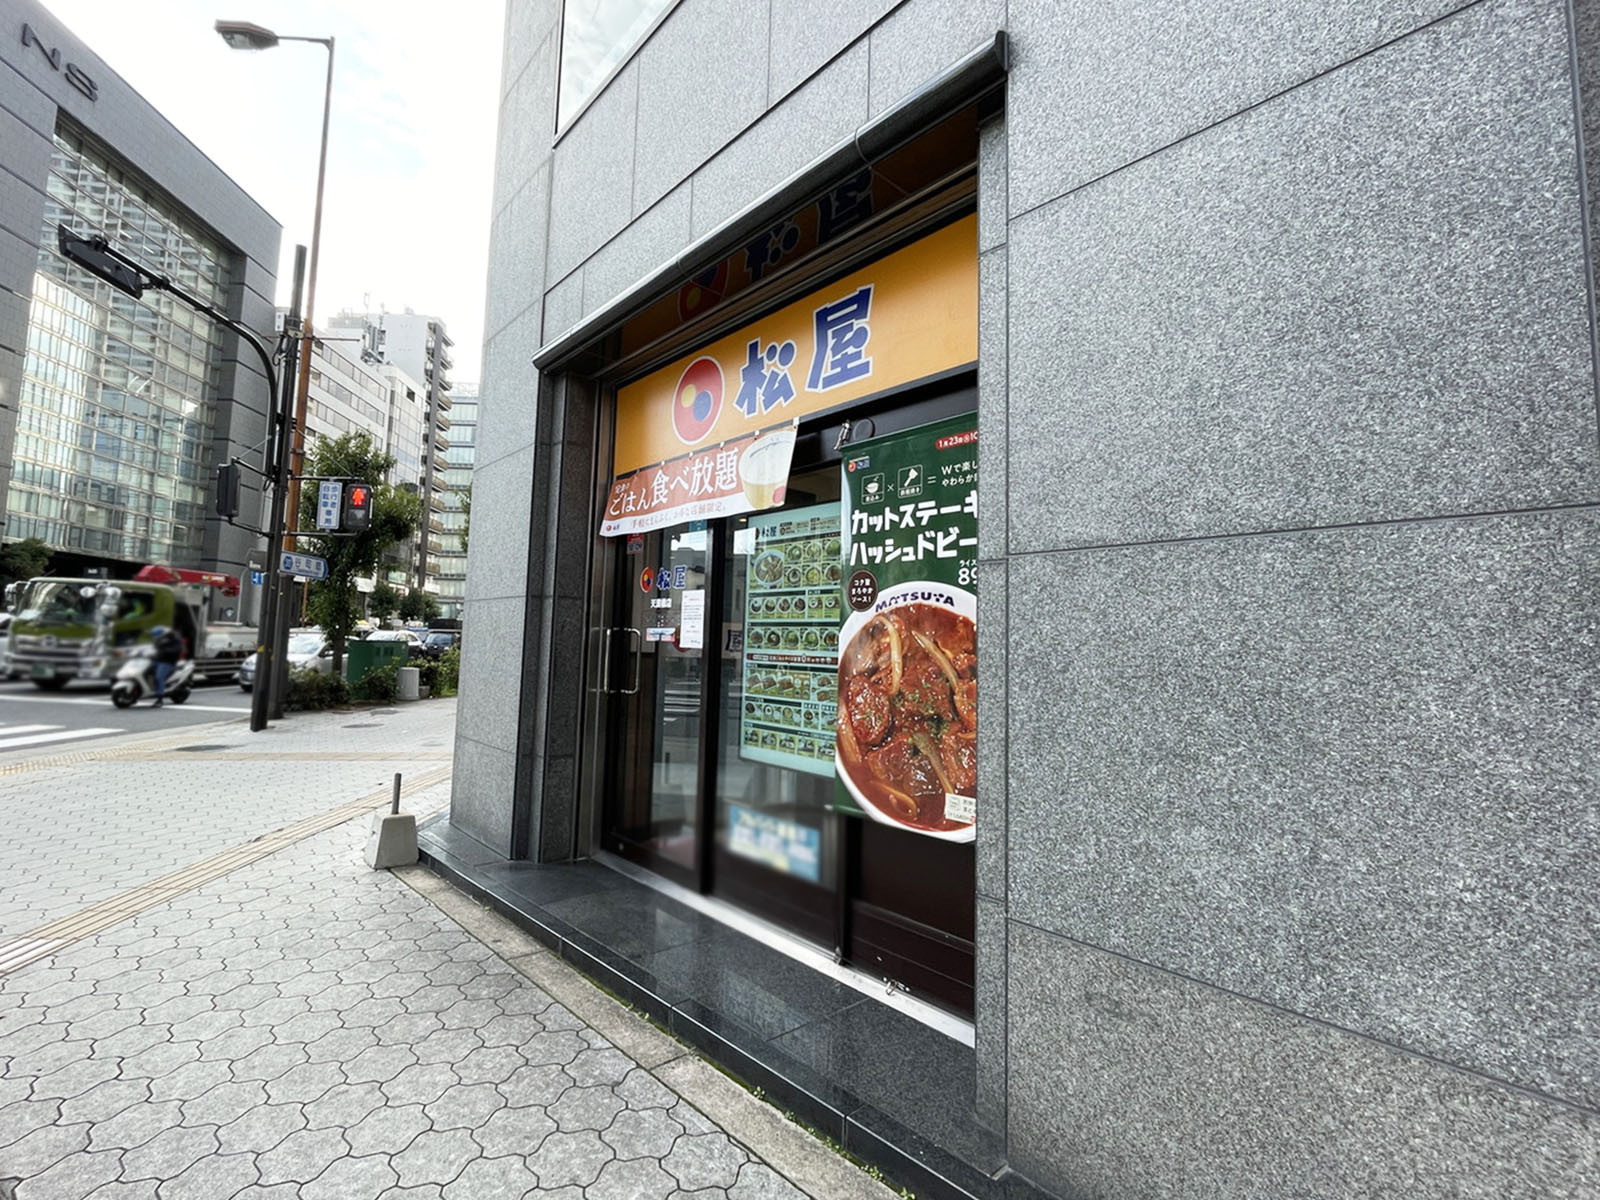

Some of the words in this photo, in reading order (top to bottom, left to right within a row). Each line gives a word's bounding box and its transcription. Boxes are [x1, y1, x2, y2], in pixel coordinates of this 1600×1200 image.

[733, 284, 874, 419] 松屋
[609, 448, 740, 516] ごはん食べ放題
[850, 526, 977, 566] ハッシュドビー
[656, 564, 687, 591] 松屋
[875, 591, 955, 613] MATSUYA
